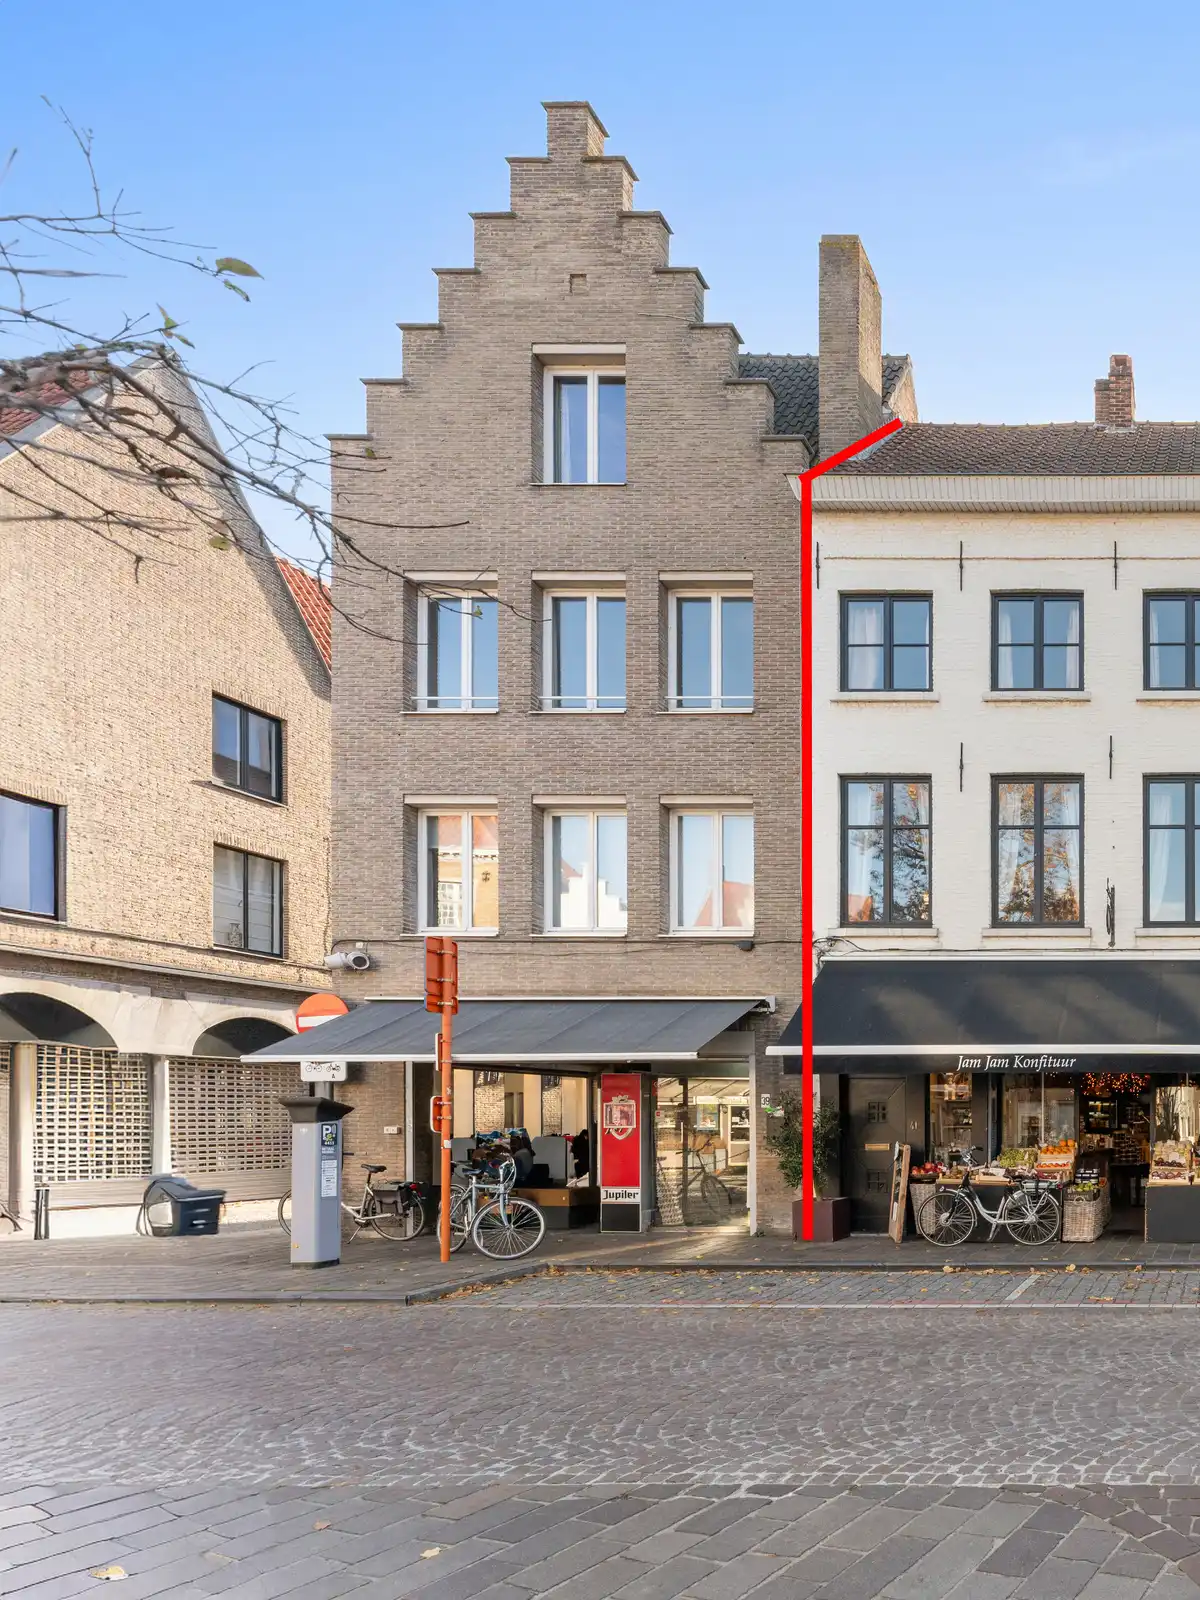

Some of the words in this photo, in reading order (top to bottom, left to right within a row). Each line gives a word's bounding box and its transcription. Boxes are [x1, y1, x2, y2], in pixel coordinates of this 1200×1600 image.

[956, 1055, 981, 1072] Jam
[984, 1055, 1010, 1071] Jam
[1012, 1054, 1077, 1072] Konfituur
[761, 1097, 770, 1105] 39
[603, 1189, 639, 1201] Jupiler
